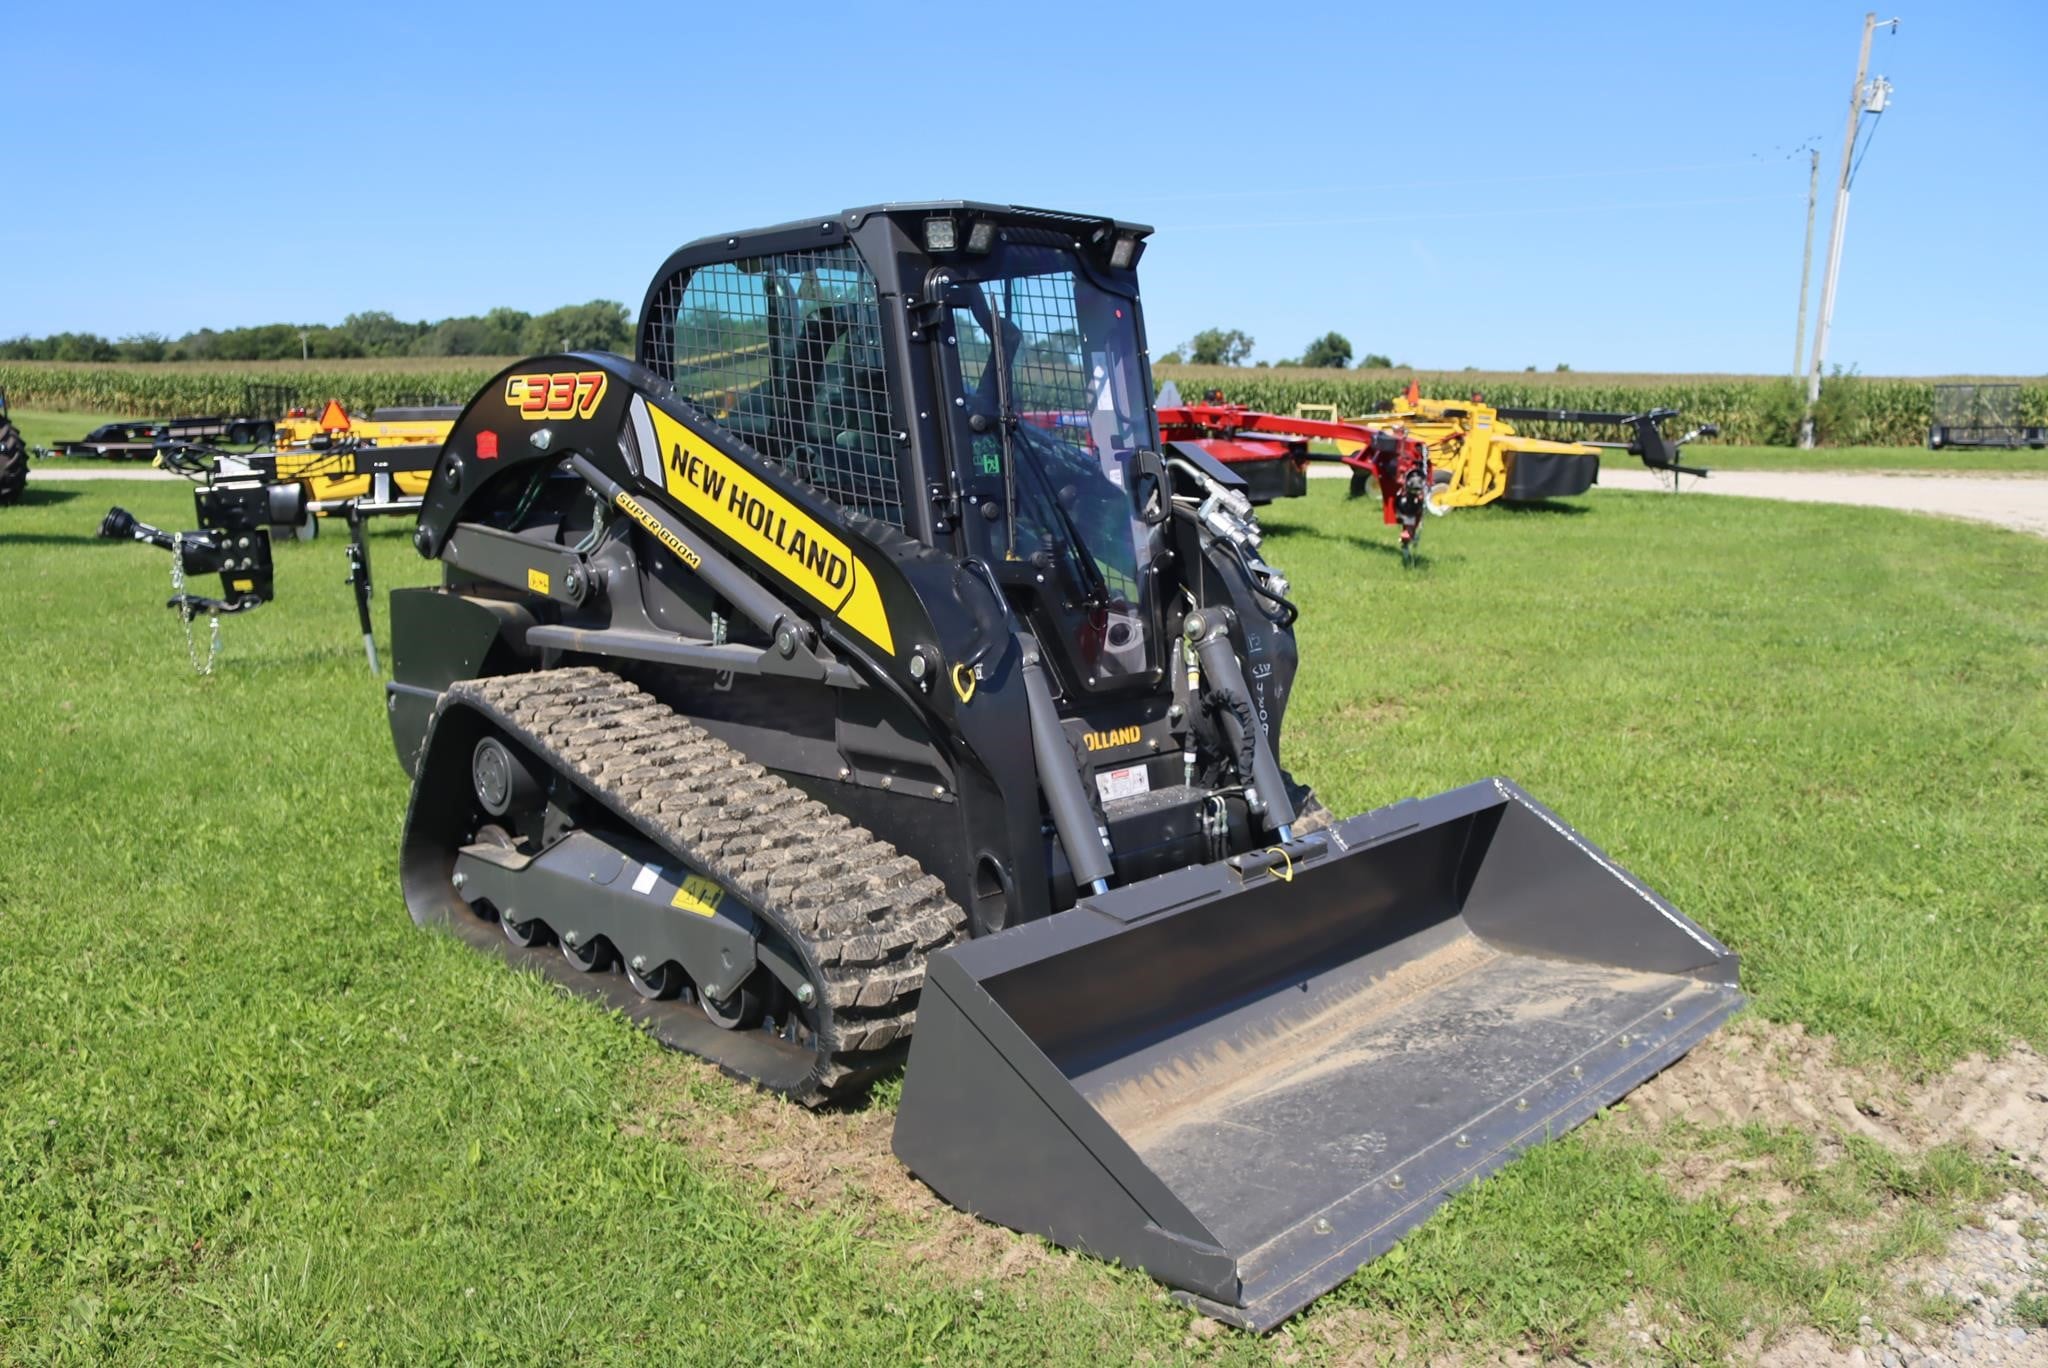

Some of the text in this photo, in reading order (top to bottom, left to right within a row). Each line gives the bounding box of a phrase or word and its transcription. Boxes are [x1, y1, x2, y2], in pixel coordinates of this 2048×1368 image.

[506, 374, 604, 413] C337
[619, 493, 699, 566] SUPER BOOM
[670, 442, 847, 590] NEW HOLLAND
[1082, 725, 1142, 752] OLLAND
